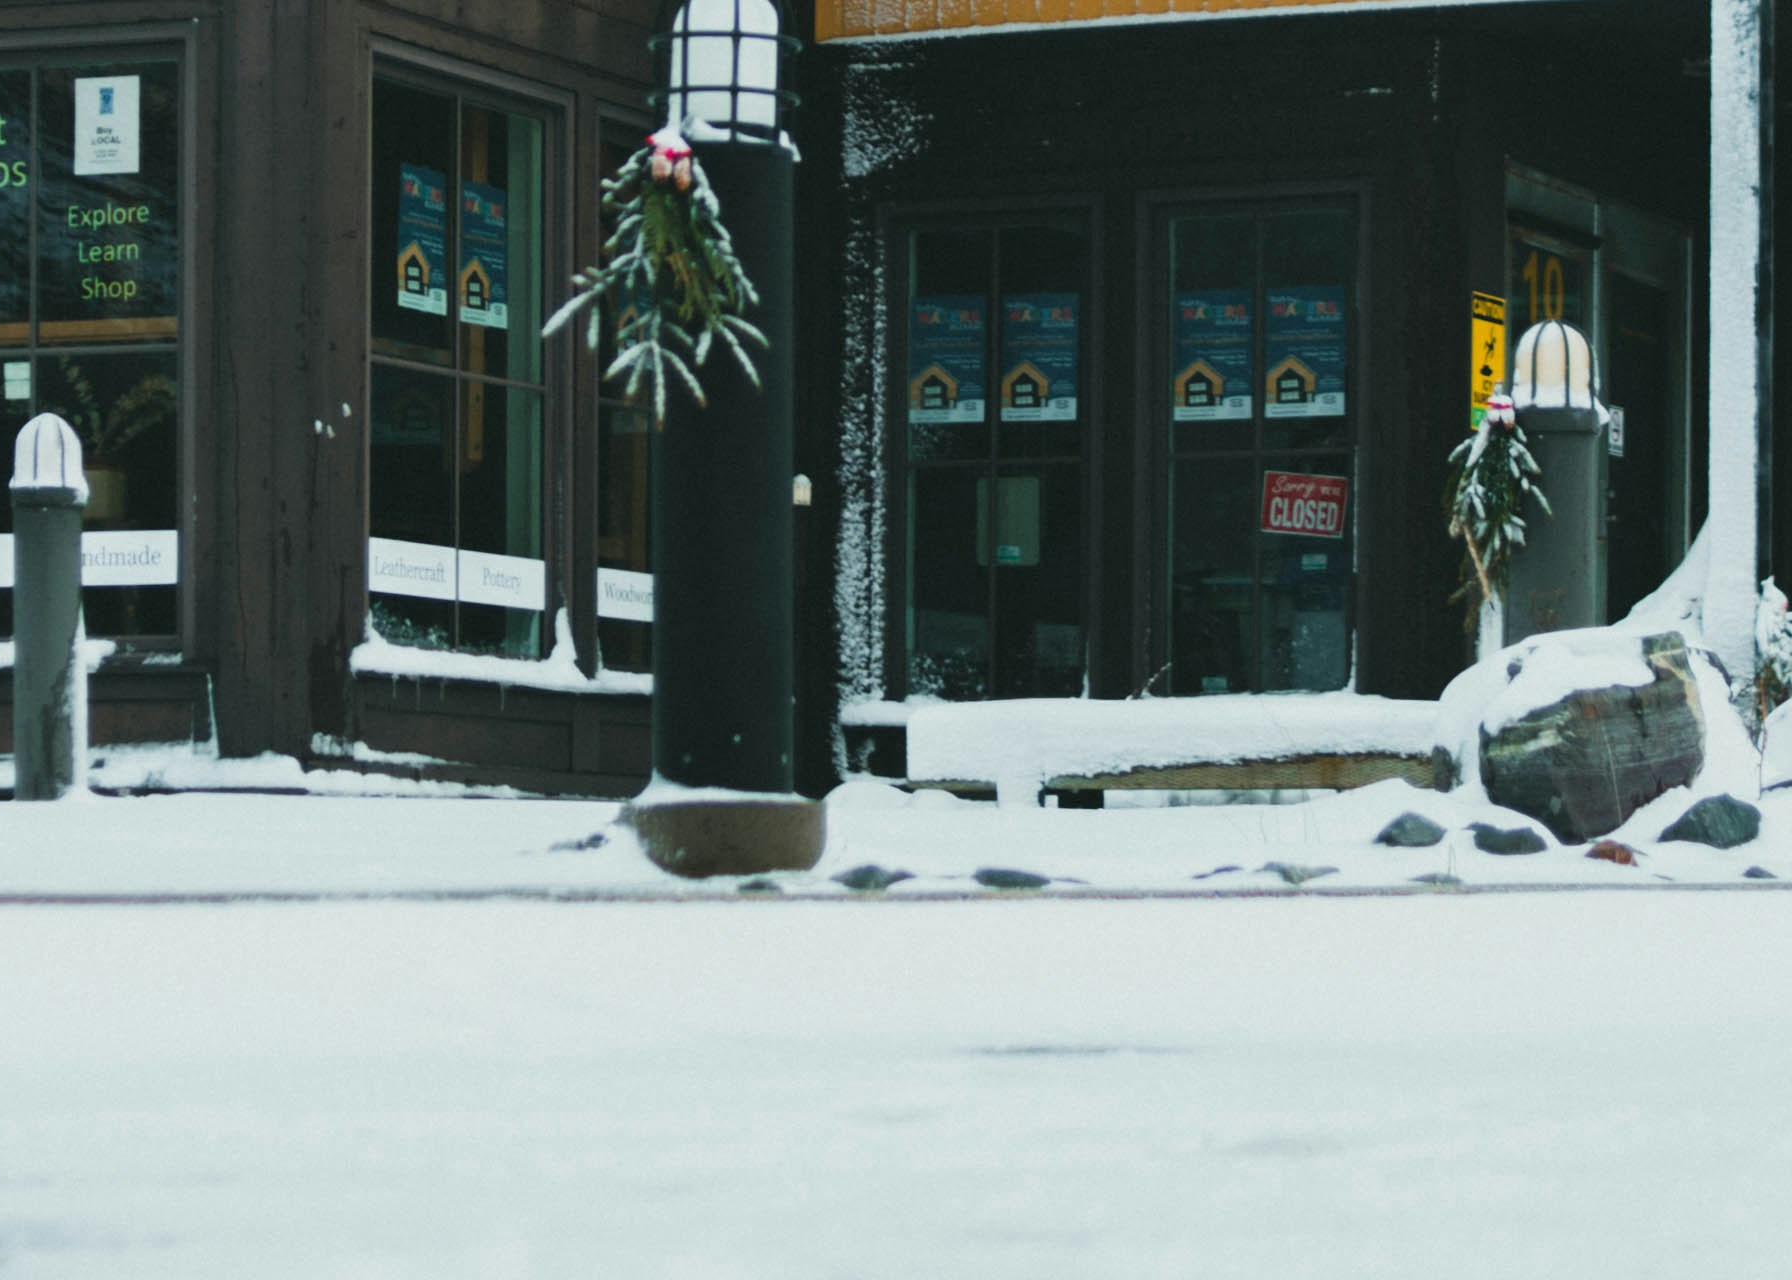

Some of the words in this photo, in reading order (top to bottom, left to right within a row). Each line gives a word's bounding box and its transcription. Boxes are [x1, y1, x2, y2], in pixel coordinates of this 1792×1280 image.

[67, 202, 150, 231] Explore
[78, 241, 140, 264] Learn
[81, 277, 138, 302] Shop
[1523, 249, 1563, 323] 10
[1271, 476, 1315, 499] Sorry
[1270, 496, 1338, 531] CLOSED
[81, 544, 162, 568] ndmade
[373, 555, 446, 585] Leathercraft
[482, 566, 523, 594] Pottery
[604, 580, 654, 602] Woodwor
